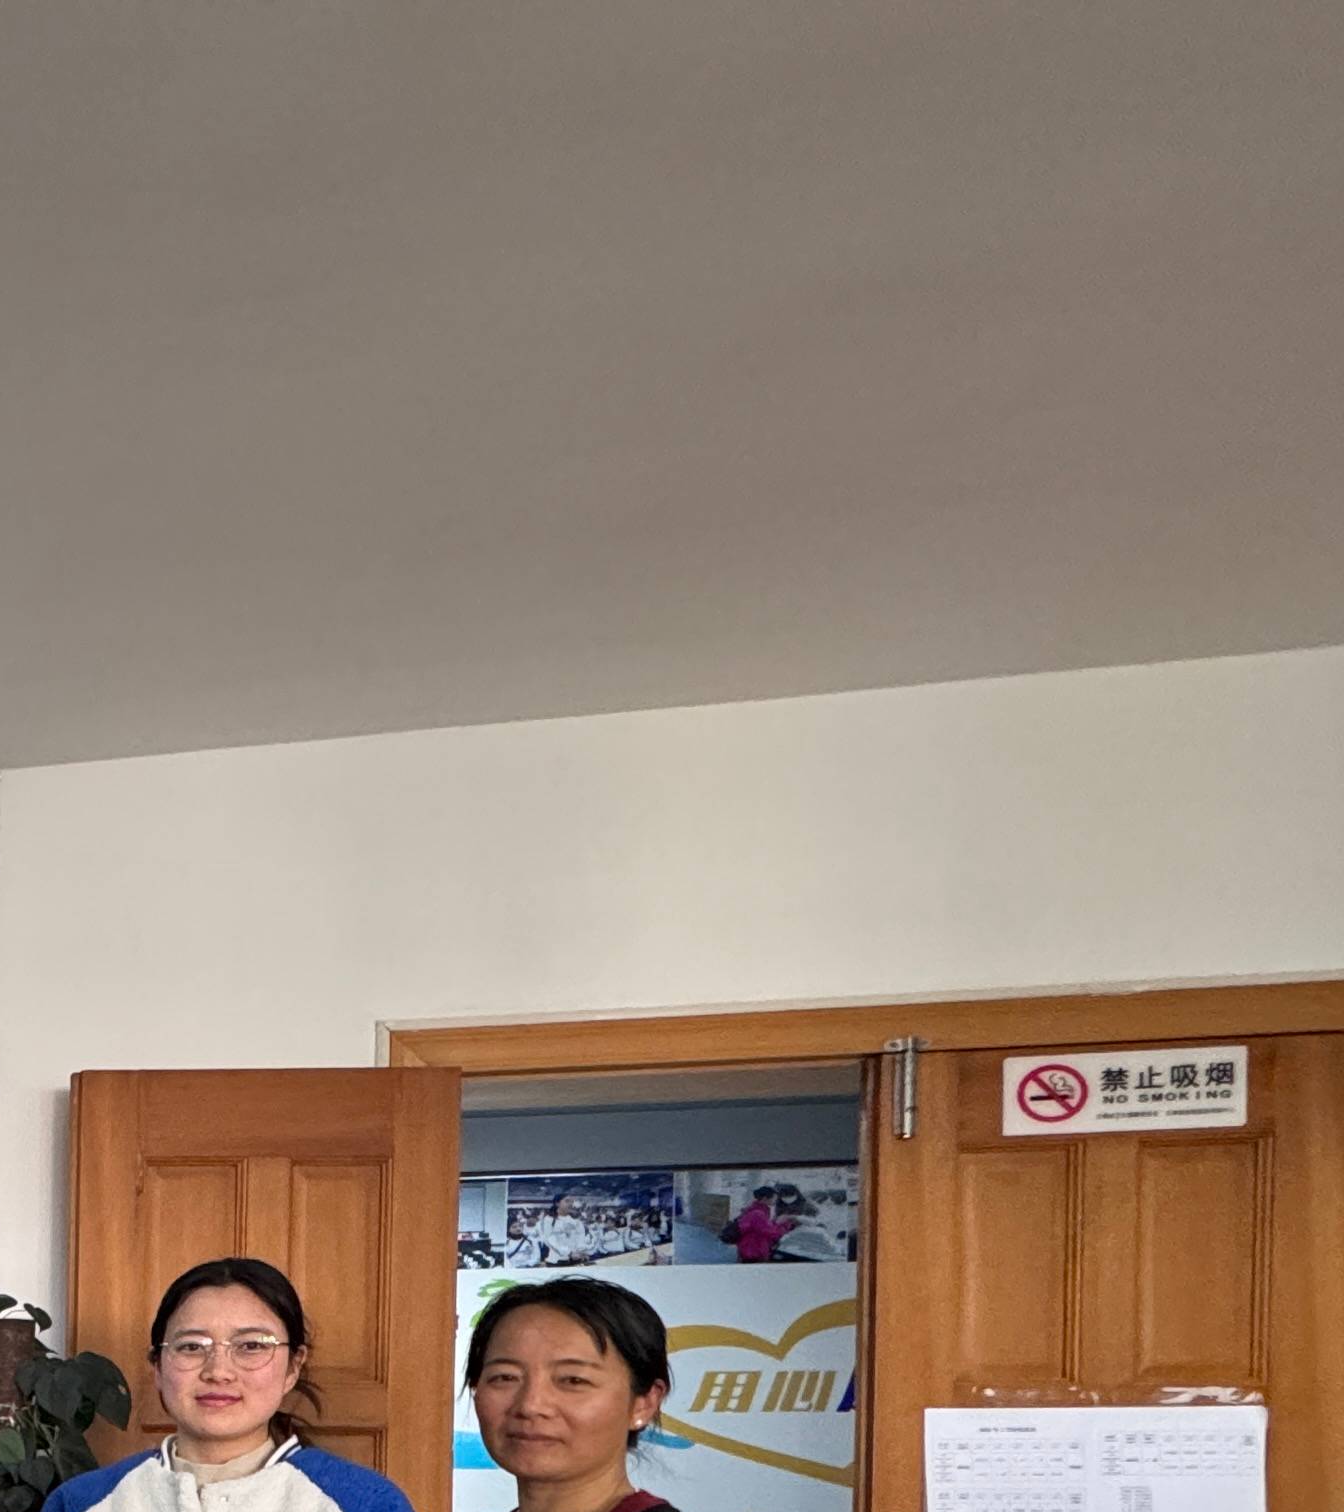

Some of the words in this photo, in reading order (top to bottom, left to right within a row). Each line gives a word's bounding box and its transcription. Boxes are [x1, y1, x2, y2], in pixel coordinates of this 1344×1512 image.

[1101, 1062, 1235, 1092] 禁止吸烟
[1102, 1095, 1129, 1104] NO
[1138, 1089, 1232, 1102] SMOKING
[688, 1370, 856, 1413] 用心
